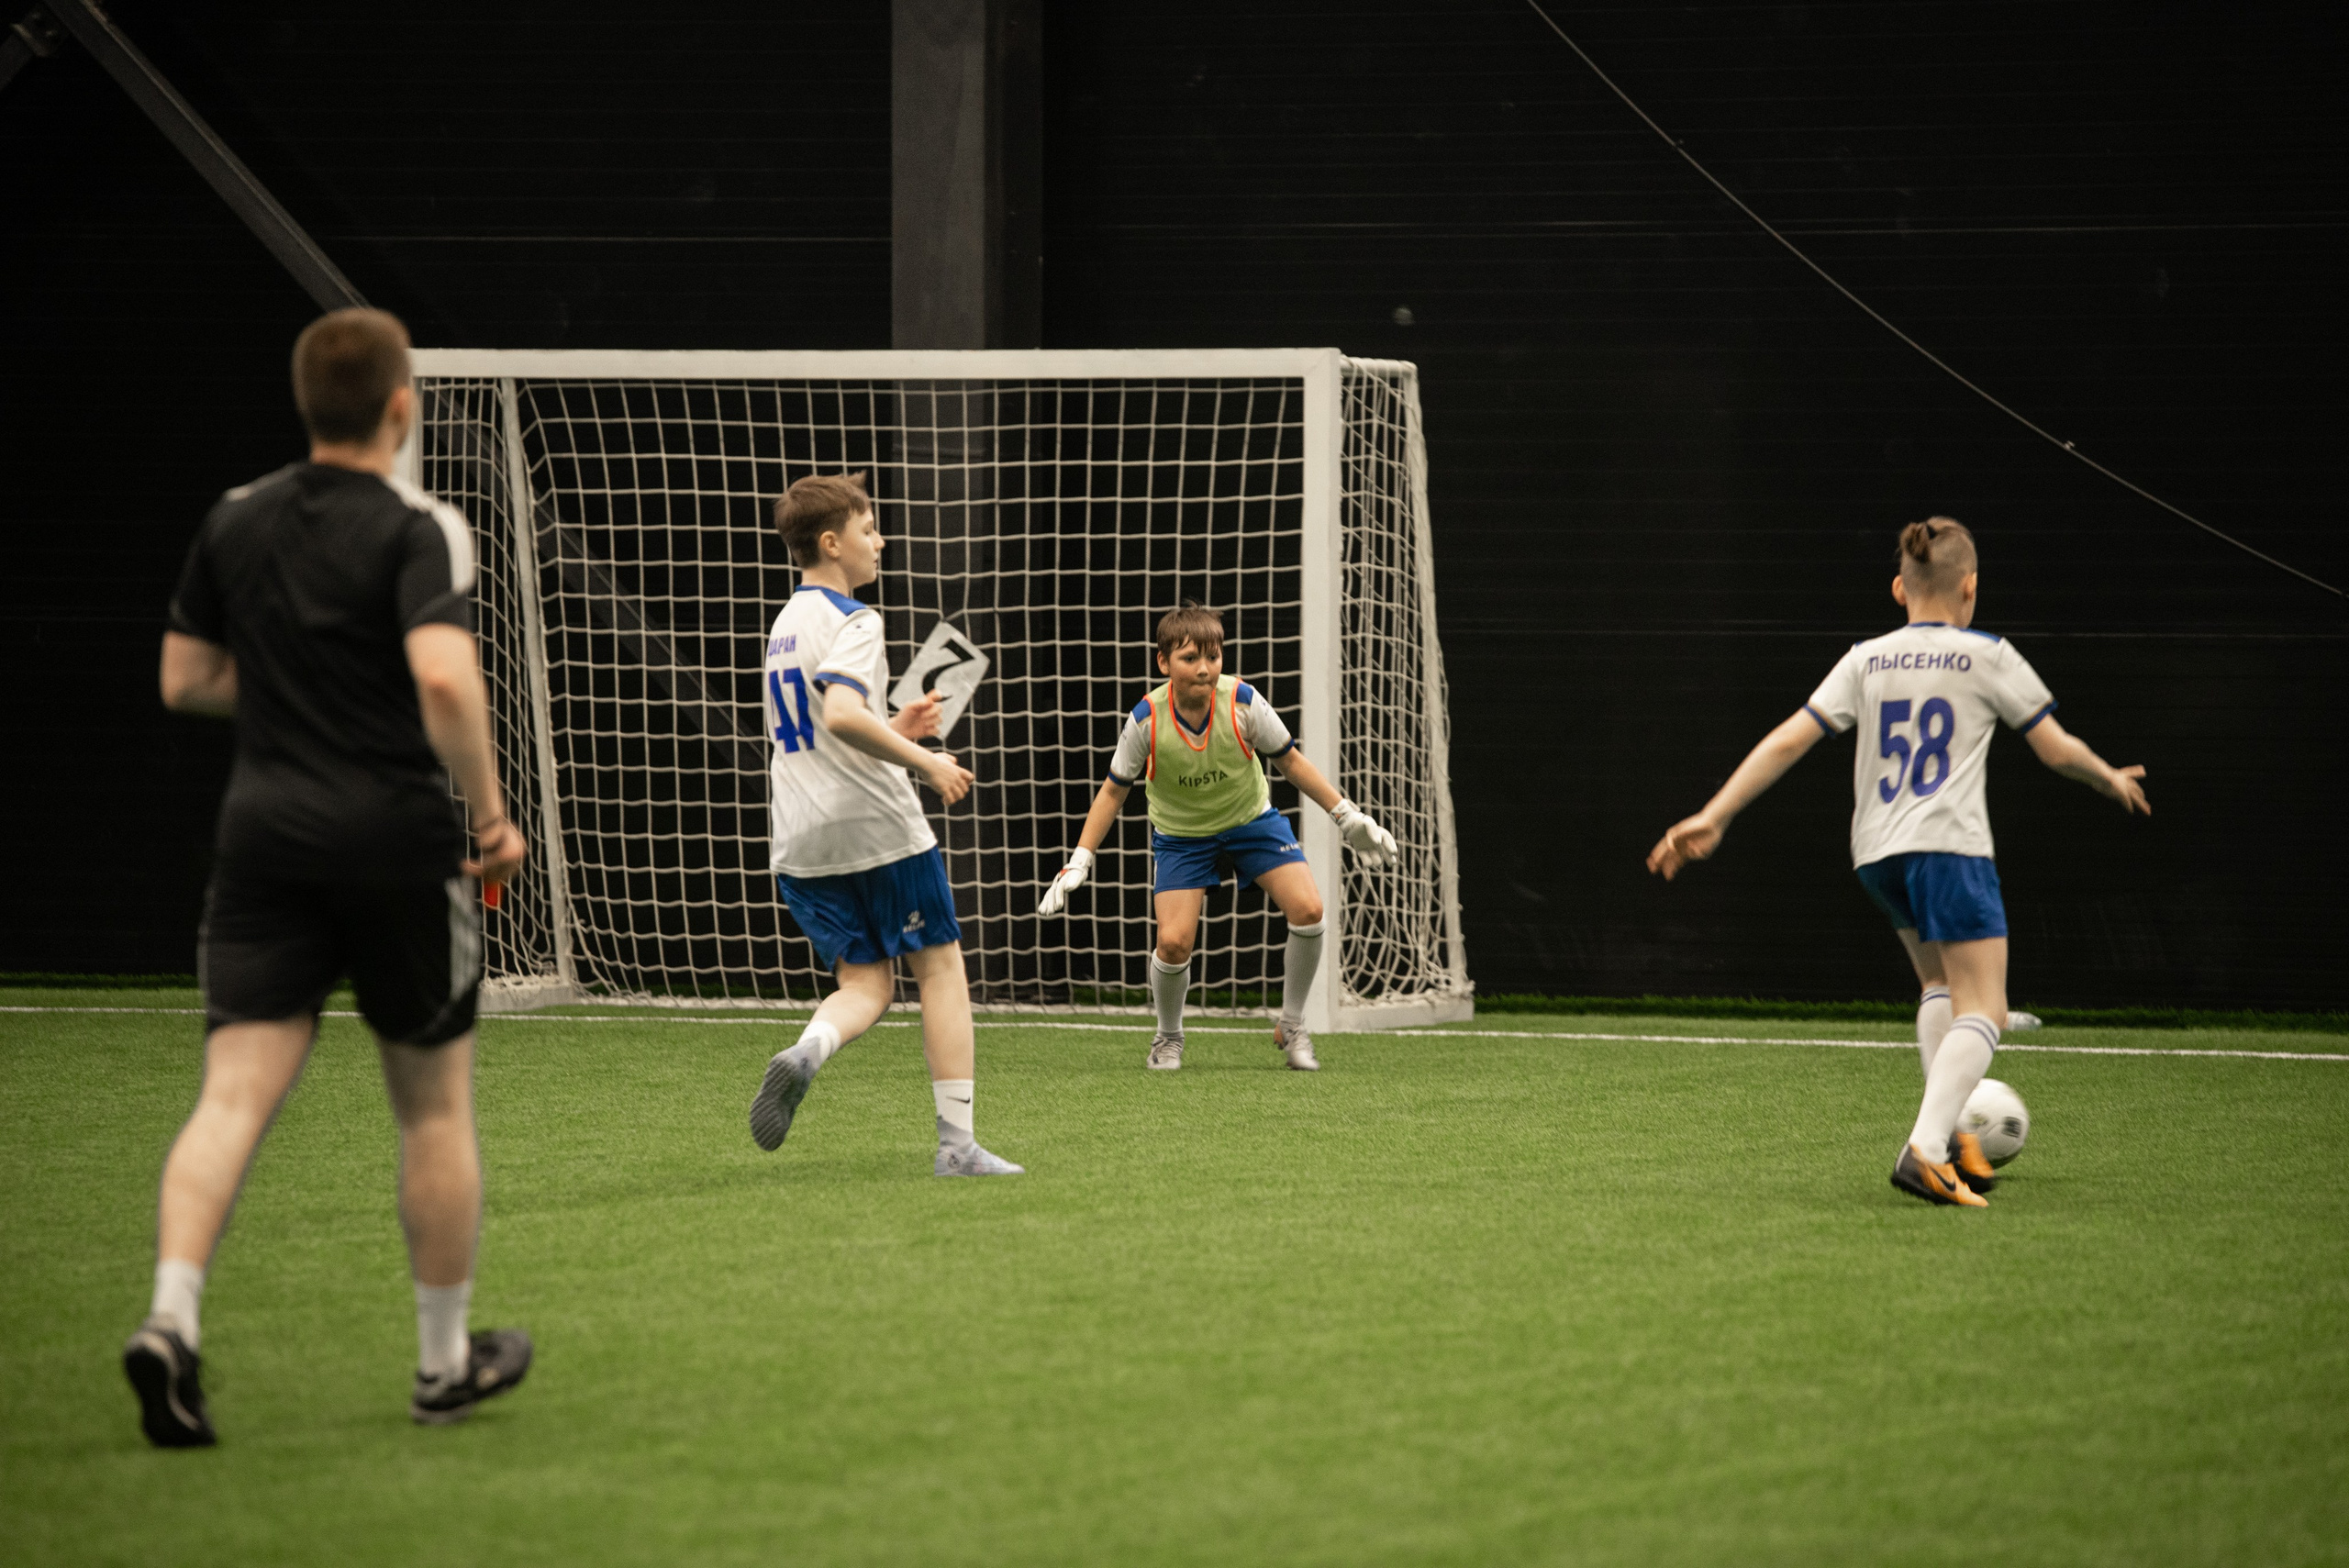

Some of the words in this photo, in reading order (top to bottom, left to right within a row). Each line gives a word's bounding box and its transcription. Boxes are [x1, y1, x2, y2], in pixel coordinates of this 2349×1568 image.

[1868, 652, 1971, 673] ЛЫСЕНКО
[768, 667, 815, 753] 47
[1879, 696, 1954, 804] 58
[1178, 770, 1228, 787] KIPSTA
